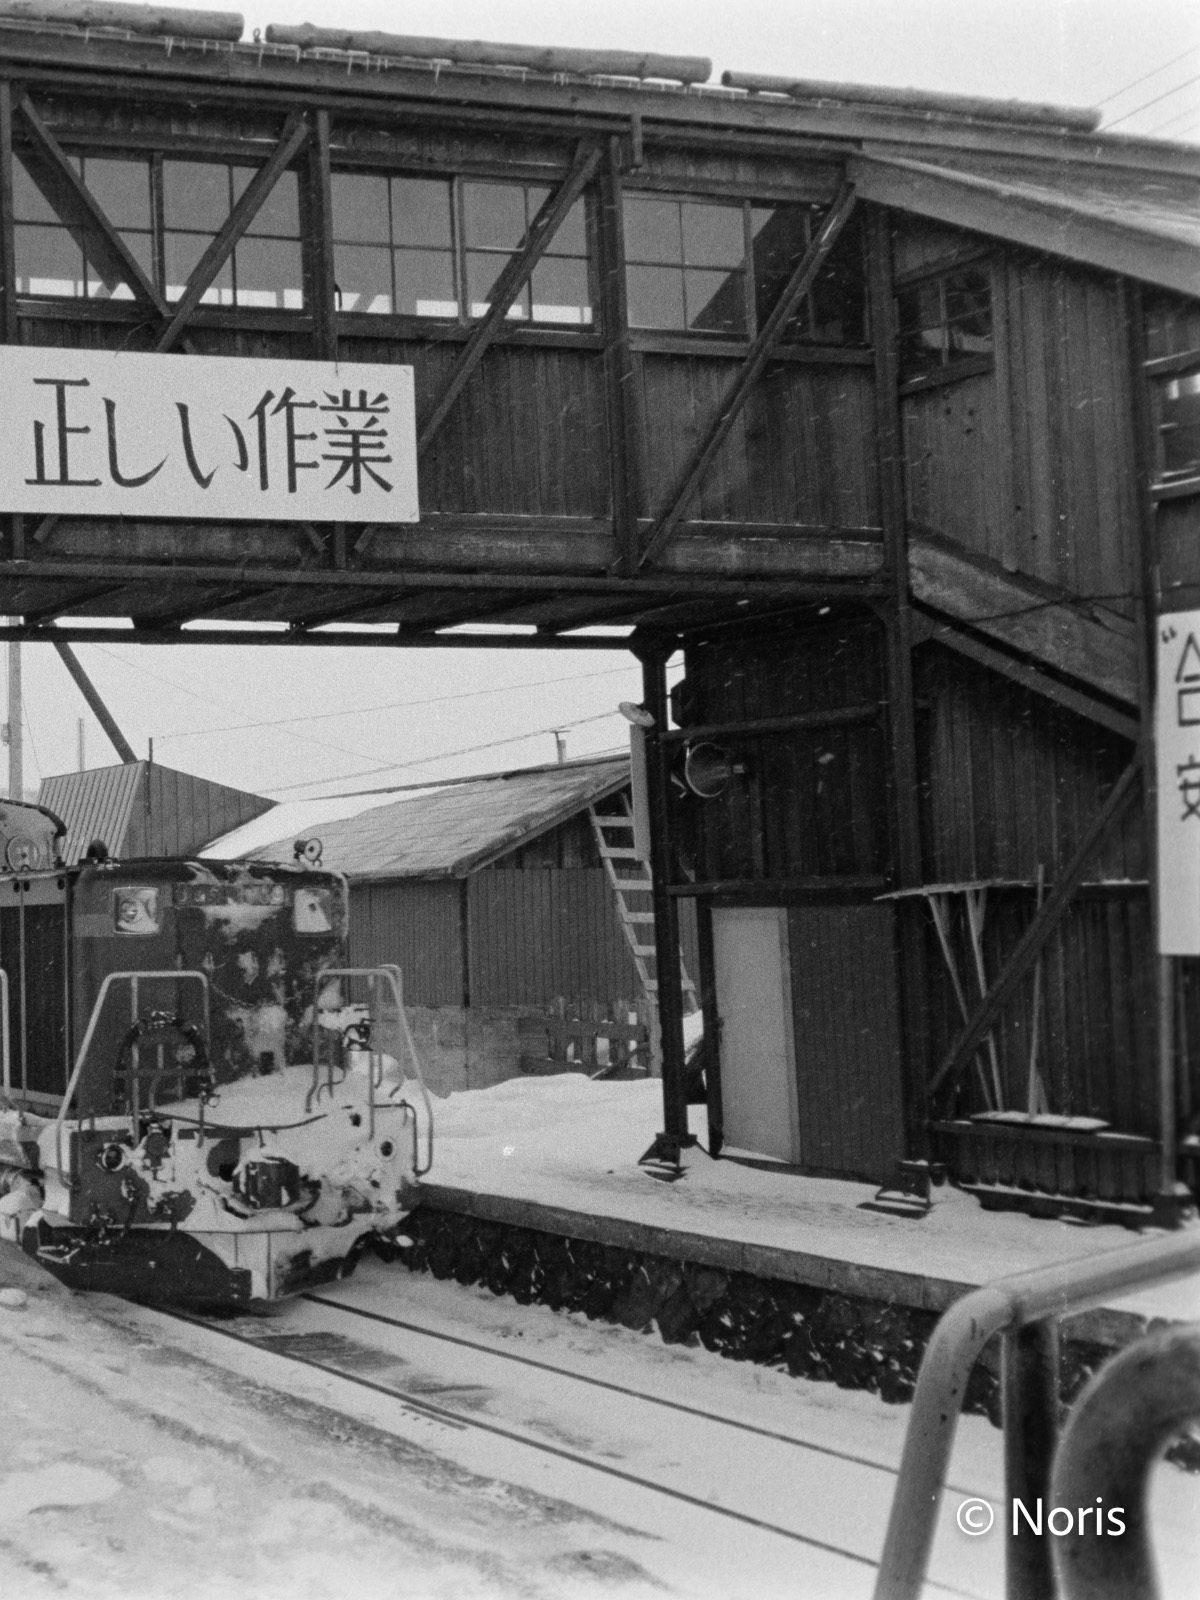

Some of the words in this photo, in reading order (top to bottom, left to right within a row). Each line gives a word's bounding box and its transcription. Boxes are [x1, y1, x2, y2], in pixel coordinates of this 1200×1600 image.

[24, 377, 395, 495] 正しい作業
